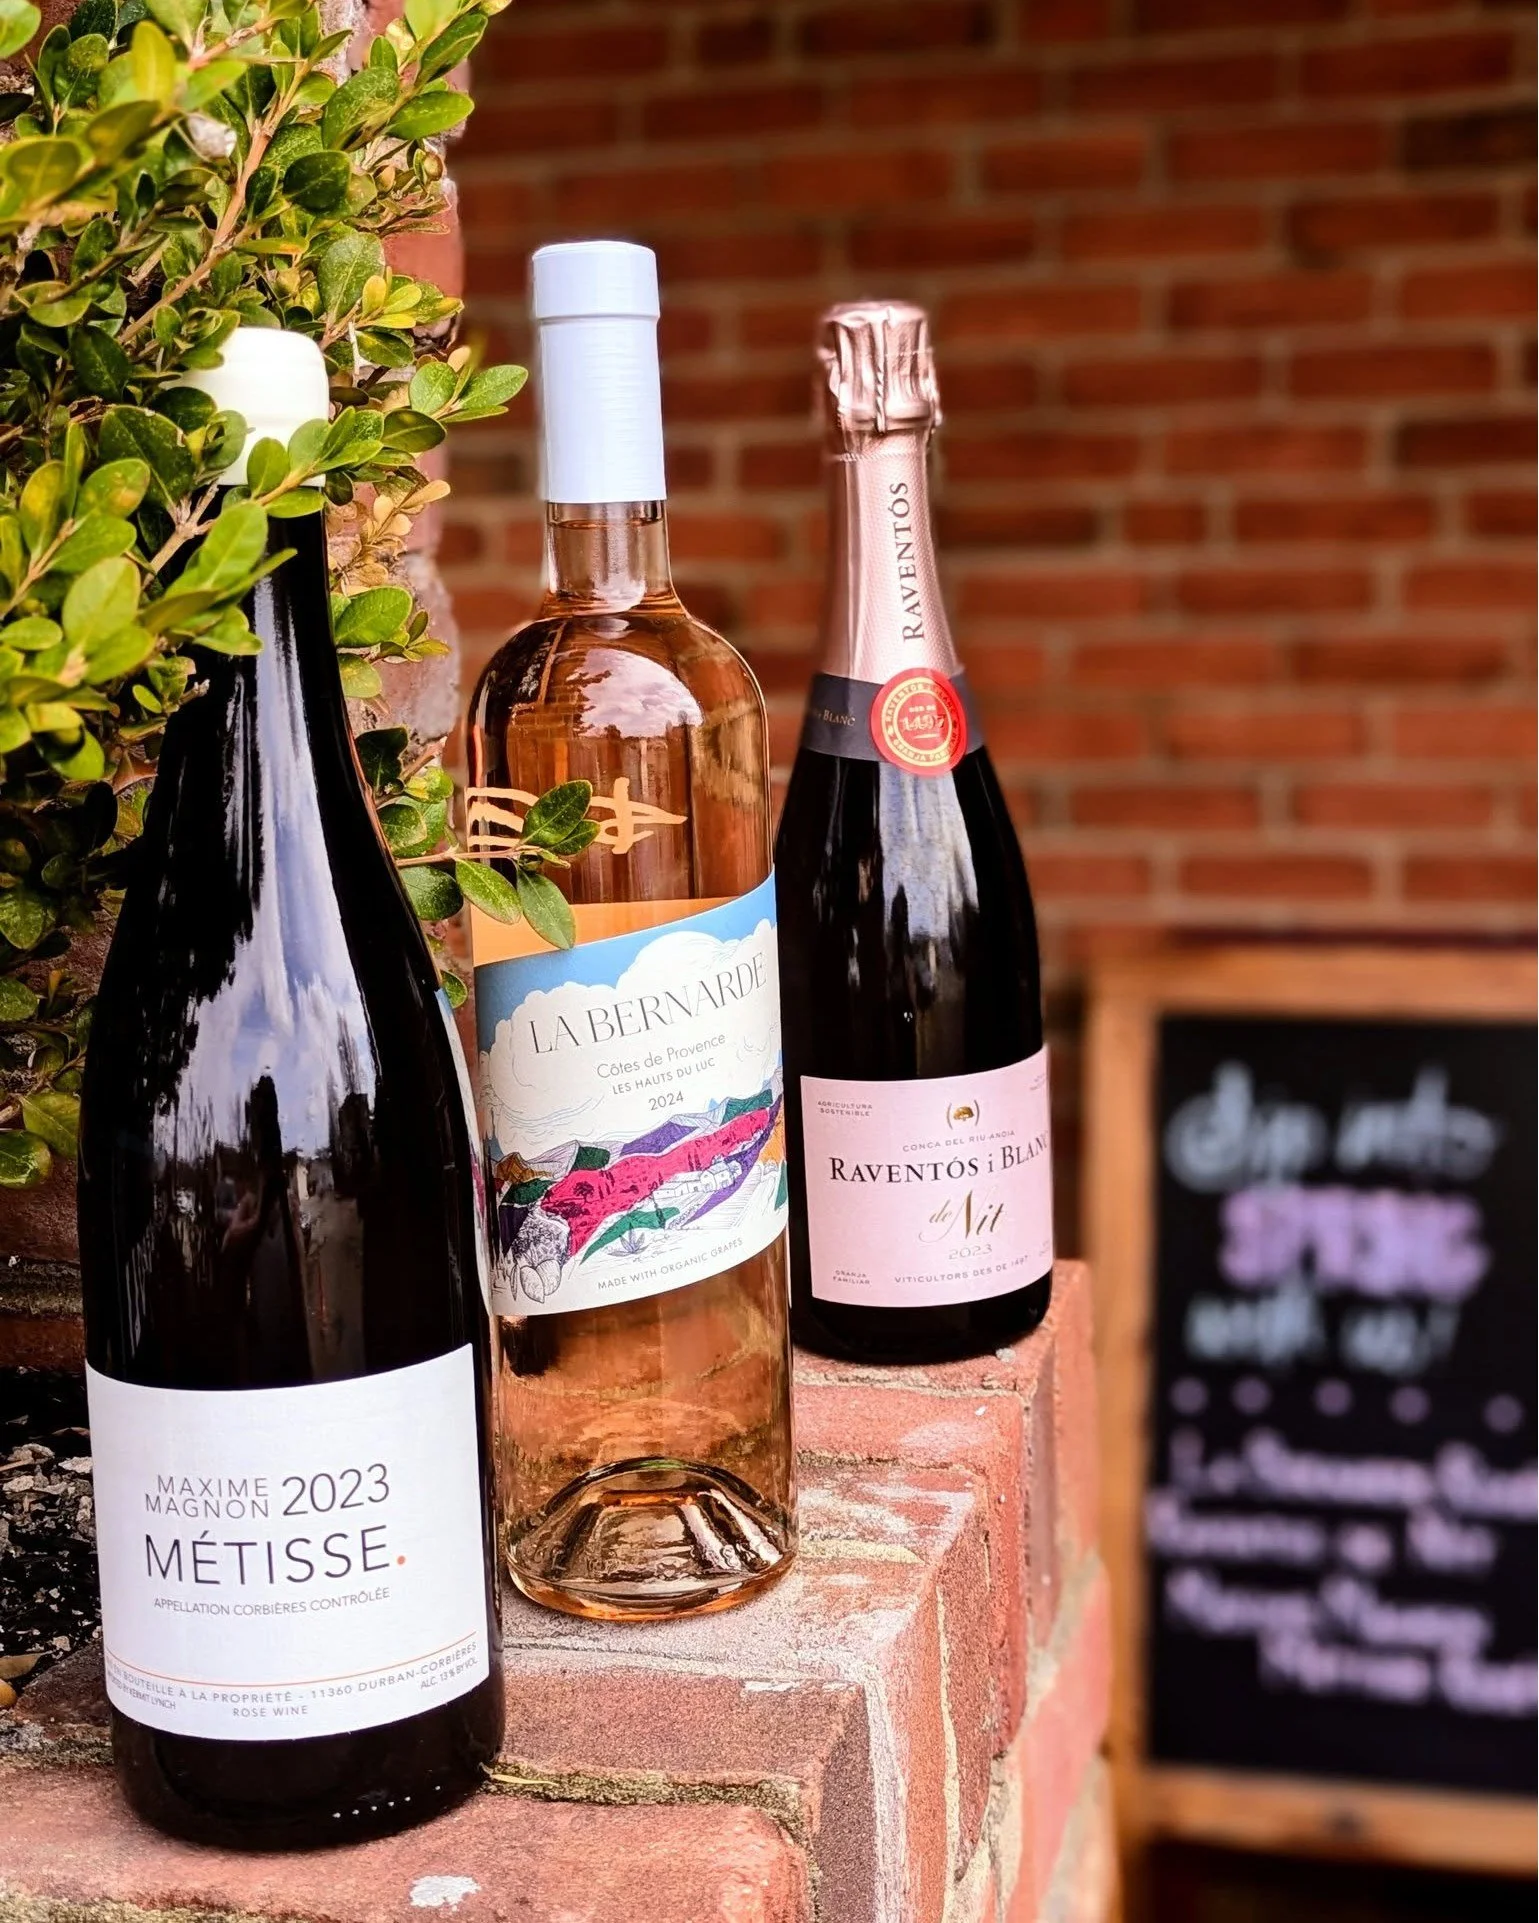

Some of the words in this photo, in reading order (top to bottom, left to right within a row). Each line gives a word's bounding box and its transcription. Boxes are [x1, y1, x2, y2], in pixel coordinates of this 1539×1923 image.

[889, 481, 924, 642] RAVENTÓS
[529, 1014, 581, 1055] LA
[586, 951, 768, 1045] BERNARDE
[596, 1060, 641, 1081] Côtes
[643, 1051, 664, 1069] de
[667, 1033, 726, 1064] Provence
[612, 1079, 633, 1095] LES
[635, 1070, 674, 1091] HAUTS
[676, 1066, 693, 1080] DU
[695, 1057, 716, 1075] LUC
[648, 1092, 684, 1112] 2024
[817, 1100, 873, 1110] AGRICULTURA
[902, 1141, 941, 1153] CONCA
[945, 1138, 965, 1147] DEL
[969, 1134, 987, 1143] RIU
[987, 1153, 994, 1174] i
[597, 1275, 628, 1291] MADE
[629, 1267, 657, 1283] WITH
[660, 1253, 708, 1277] ORGANIC
[709, 1237, 744, 1261] GRAPES
[949, 1243, 993, 1260] 2023
[894, 1271, 969, 1283] VITICULTORS
[973, 1267, 993, 1277] DES
[157, 1474, 269, 1498] MAXIME
[281, 1463, 390, 1516] 2023
[145, 1494, 270, 1519] MAGNON
[154, 1597, 230, 1616] APPELLATION
[233, 1600, 307, 1616] CORBIÈRES
[310, 1587, 391, 1612] CONTRÔLÉE
[123, 1671, 174, 1697] BOUTEILLE
[192, 1690, 208, 1702] LA
[212, 1690, 293, 1704] PROPRIÉTÉ
[311, 1685, 352, 1699] 11360
[358, 1641, 478, 1692] DURBAN-CORBIÈRES
[151, 1697, 177, 1710] LYNCH
[273, 1704, 308, 1717] WINE
